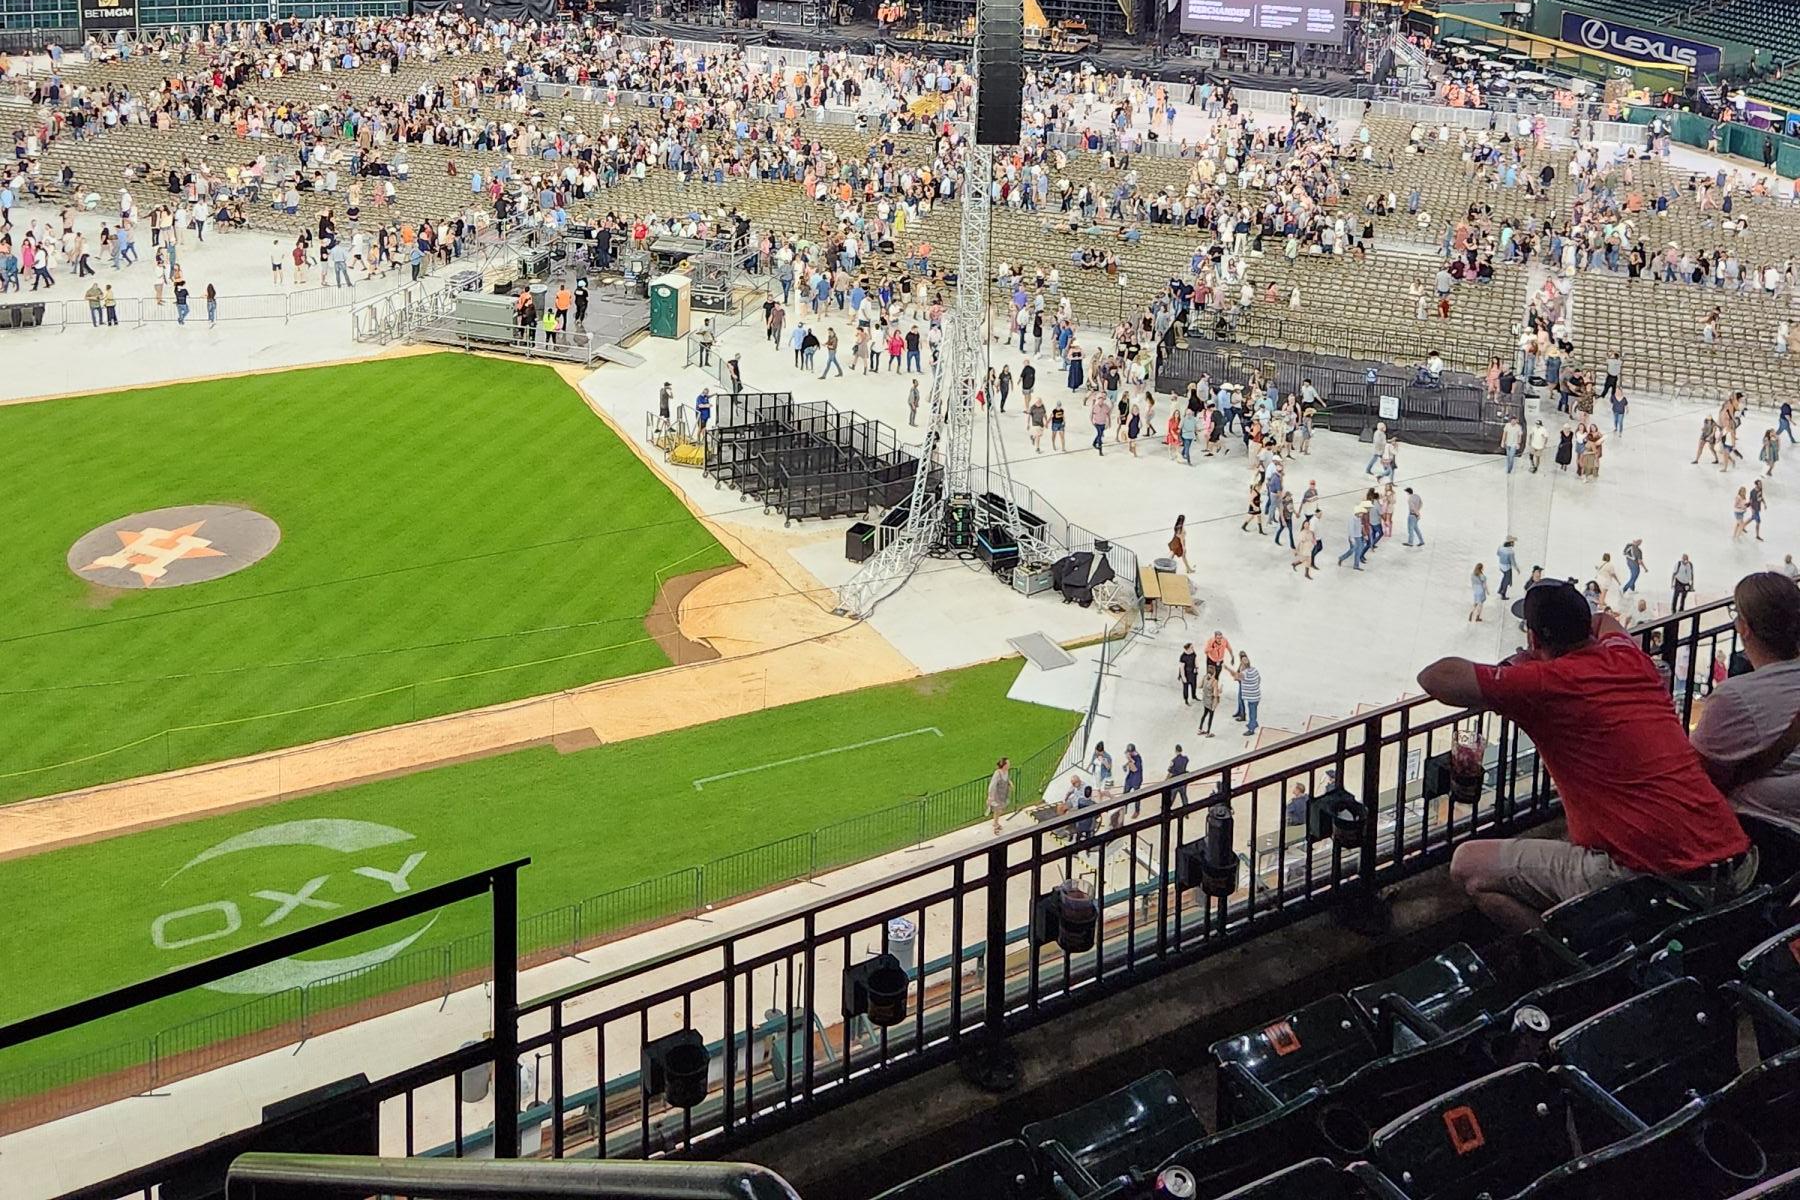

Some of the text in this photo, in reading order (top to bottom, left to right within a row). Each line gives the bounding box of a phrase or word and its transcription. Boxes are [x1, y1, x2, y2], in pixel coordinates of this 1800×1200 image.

[84, 8, 133, 18] BETMGM
[1611, 31, 1698, 67] LEXUS
[1614, 65, 1631, 77] 370
[151, 850, 428, 950] OXY
